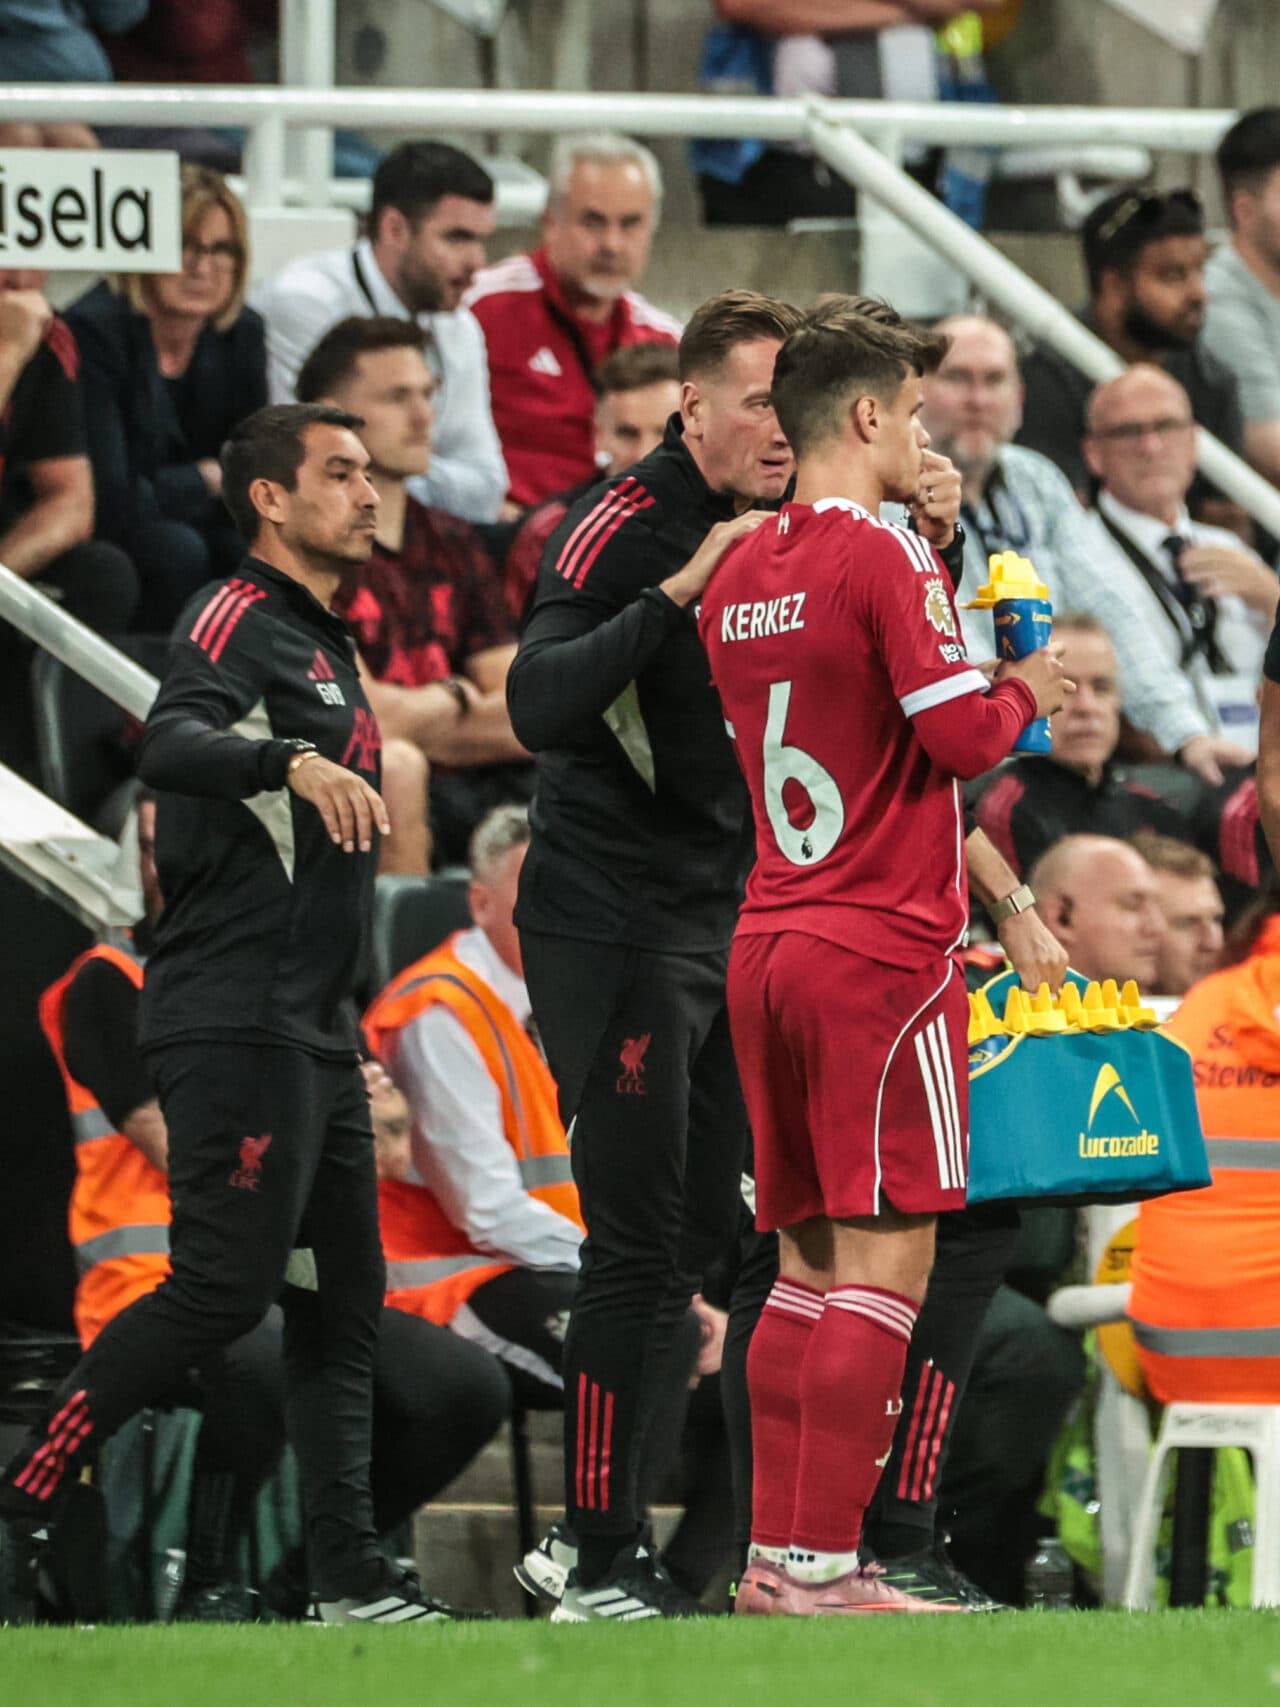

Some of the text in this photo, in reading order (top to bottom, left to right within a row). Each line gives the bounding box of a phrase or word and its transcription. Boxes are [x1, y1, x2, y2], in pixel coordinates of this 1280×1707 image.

[720, 591, 806, 643] KERKEZ
[762, 681, 844, 866] 6
[1079, 1129, 1160, 1159] Lucozade
